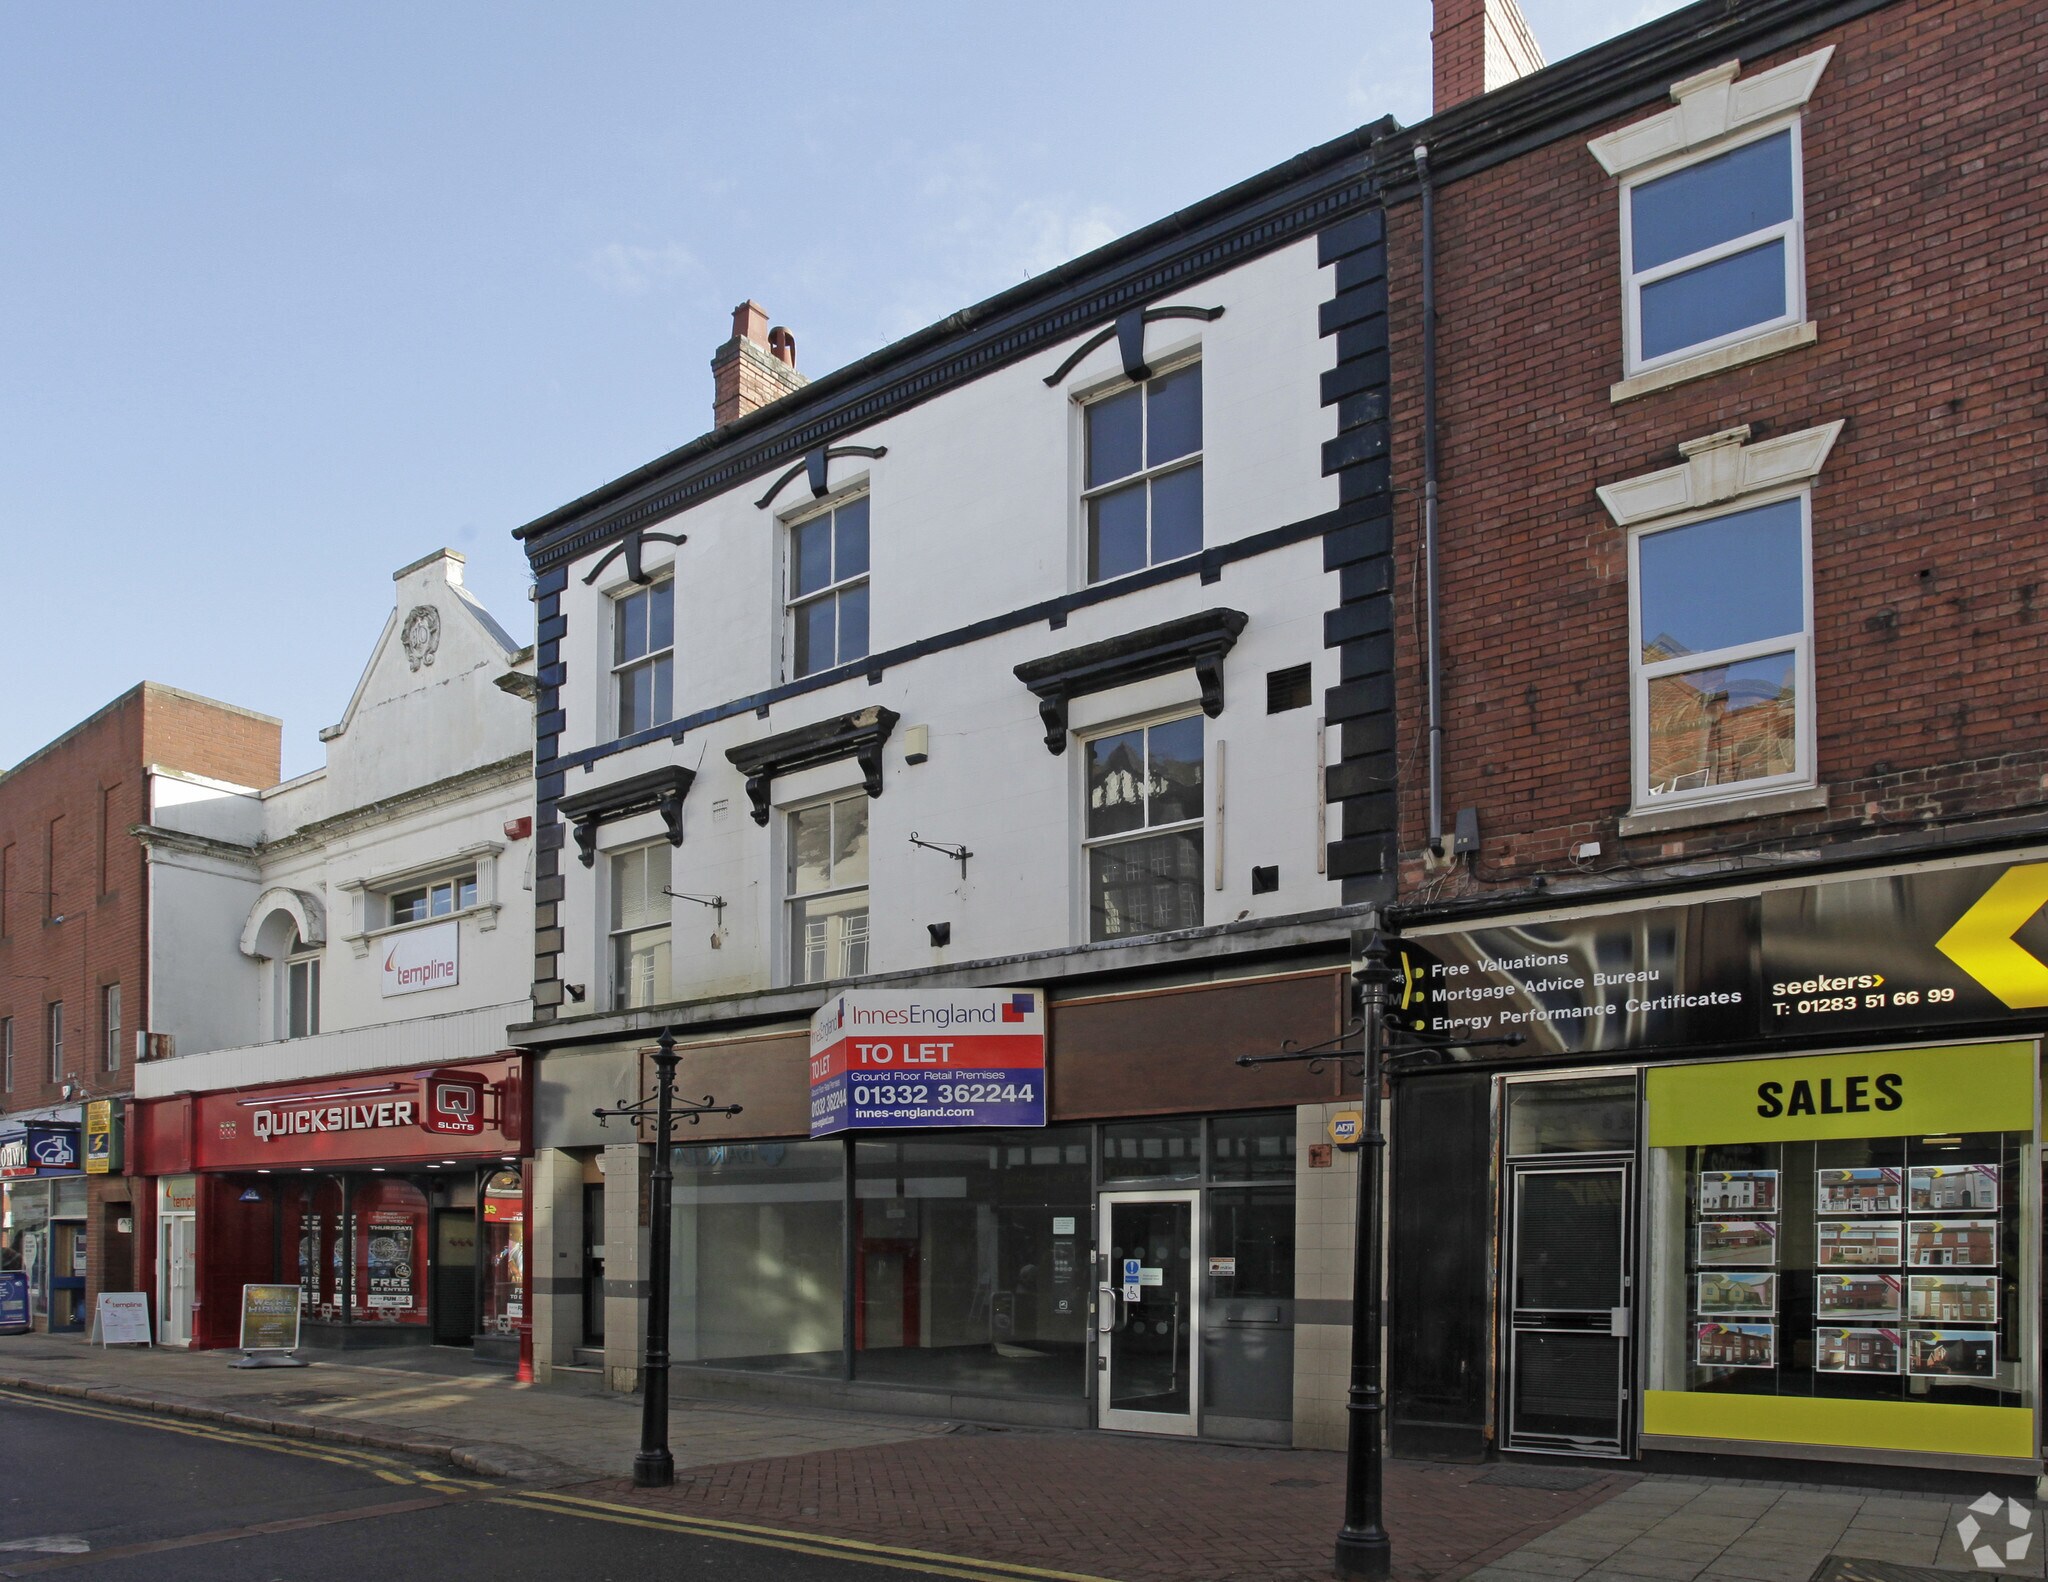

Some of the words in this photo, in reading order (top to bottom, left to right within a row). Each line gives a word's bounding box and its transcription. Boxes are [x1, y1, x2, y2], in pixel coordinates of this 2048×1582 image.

[398, 959, 454, 986] templine
[1431, 963, 1470, 979] Free
[1477, 952, 1570, 973] Valuations
[1432, 983, 1516, 1003] Mortgage
[1523, 975, 1585, 995] Advice
[1593, 968, 1660, 987] Bureau
[1772, 974, 1873, 996] seekers
[1432, 1014, 1492, 1032] Energy
[1500, 1002, 1617, 1025] Performance
[1625, 990, 1742, 1014] Certificates
[1772, 1002, 1791, 1016] T:
[1797, 996, 1857, 1014] 01283
[1865, 993, 1885, 1008] 51
[1893, 990, 1919, 1006] 66
[1927, 987, 1955, 1003] 99
[855, 1043, 893, 1064] TO
[903, 1043, 954, 1063] LET
[811, 1060, 820, 1079] TO
[820, 1054, 830, 1077] LET
[851, 1071, 891, 1082] Ground
[894, 1071, 921, 1081] Floor
[924, 1071, 952, 1081] Retail
[955, 1070, 1006, 1080] Premises
[437, 1083, 475, 1122] Q
[853, 1085, 928, 1105] 01332
[937, 1084, 1034, 1104] 362244
[1756, 1073, 1903, 1118] SALES
[253, 1101, 413, 1143] QUICKSILVER
[855, 1106, 975, 1120] innes-england.com
[438, 1121, 475, 1131] SLOTS
[1335, 1123, 1355, 1133] ADT
[370, 1278, 410, 1287] FREE
[112, 1301, 143, 1309] templine
